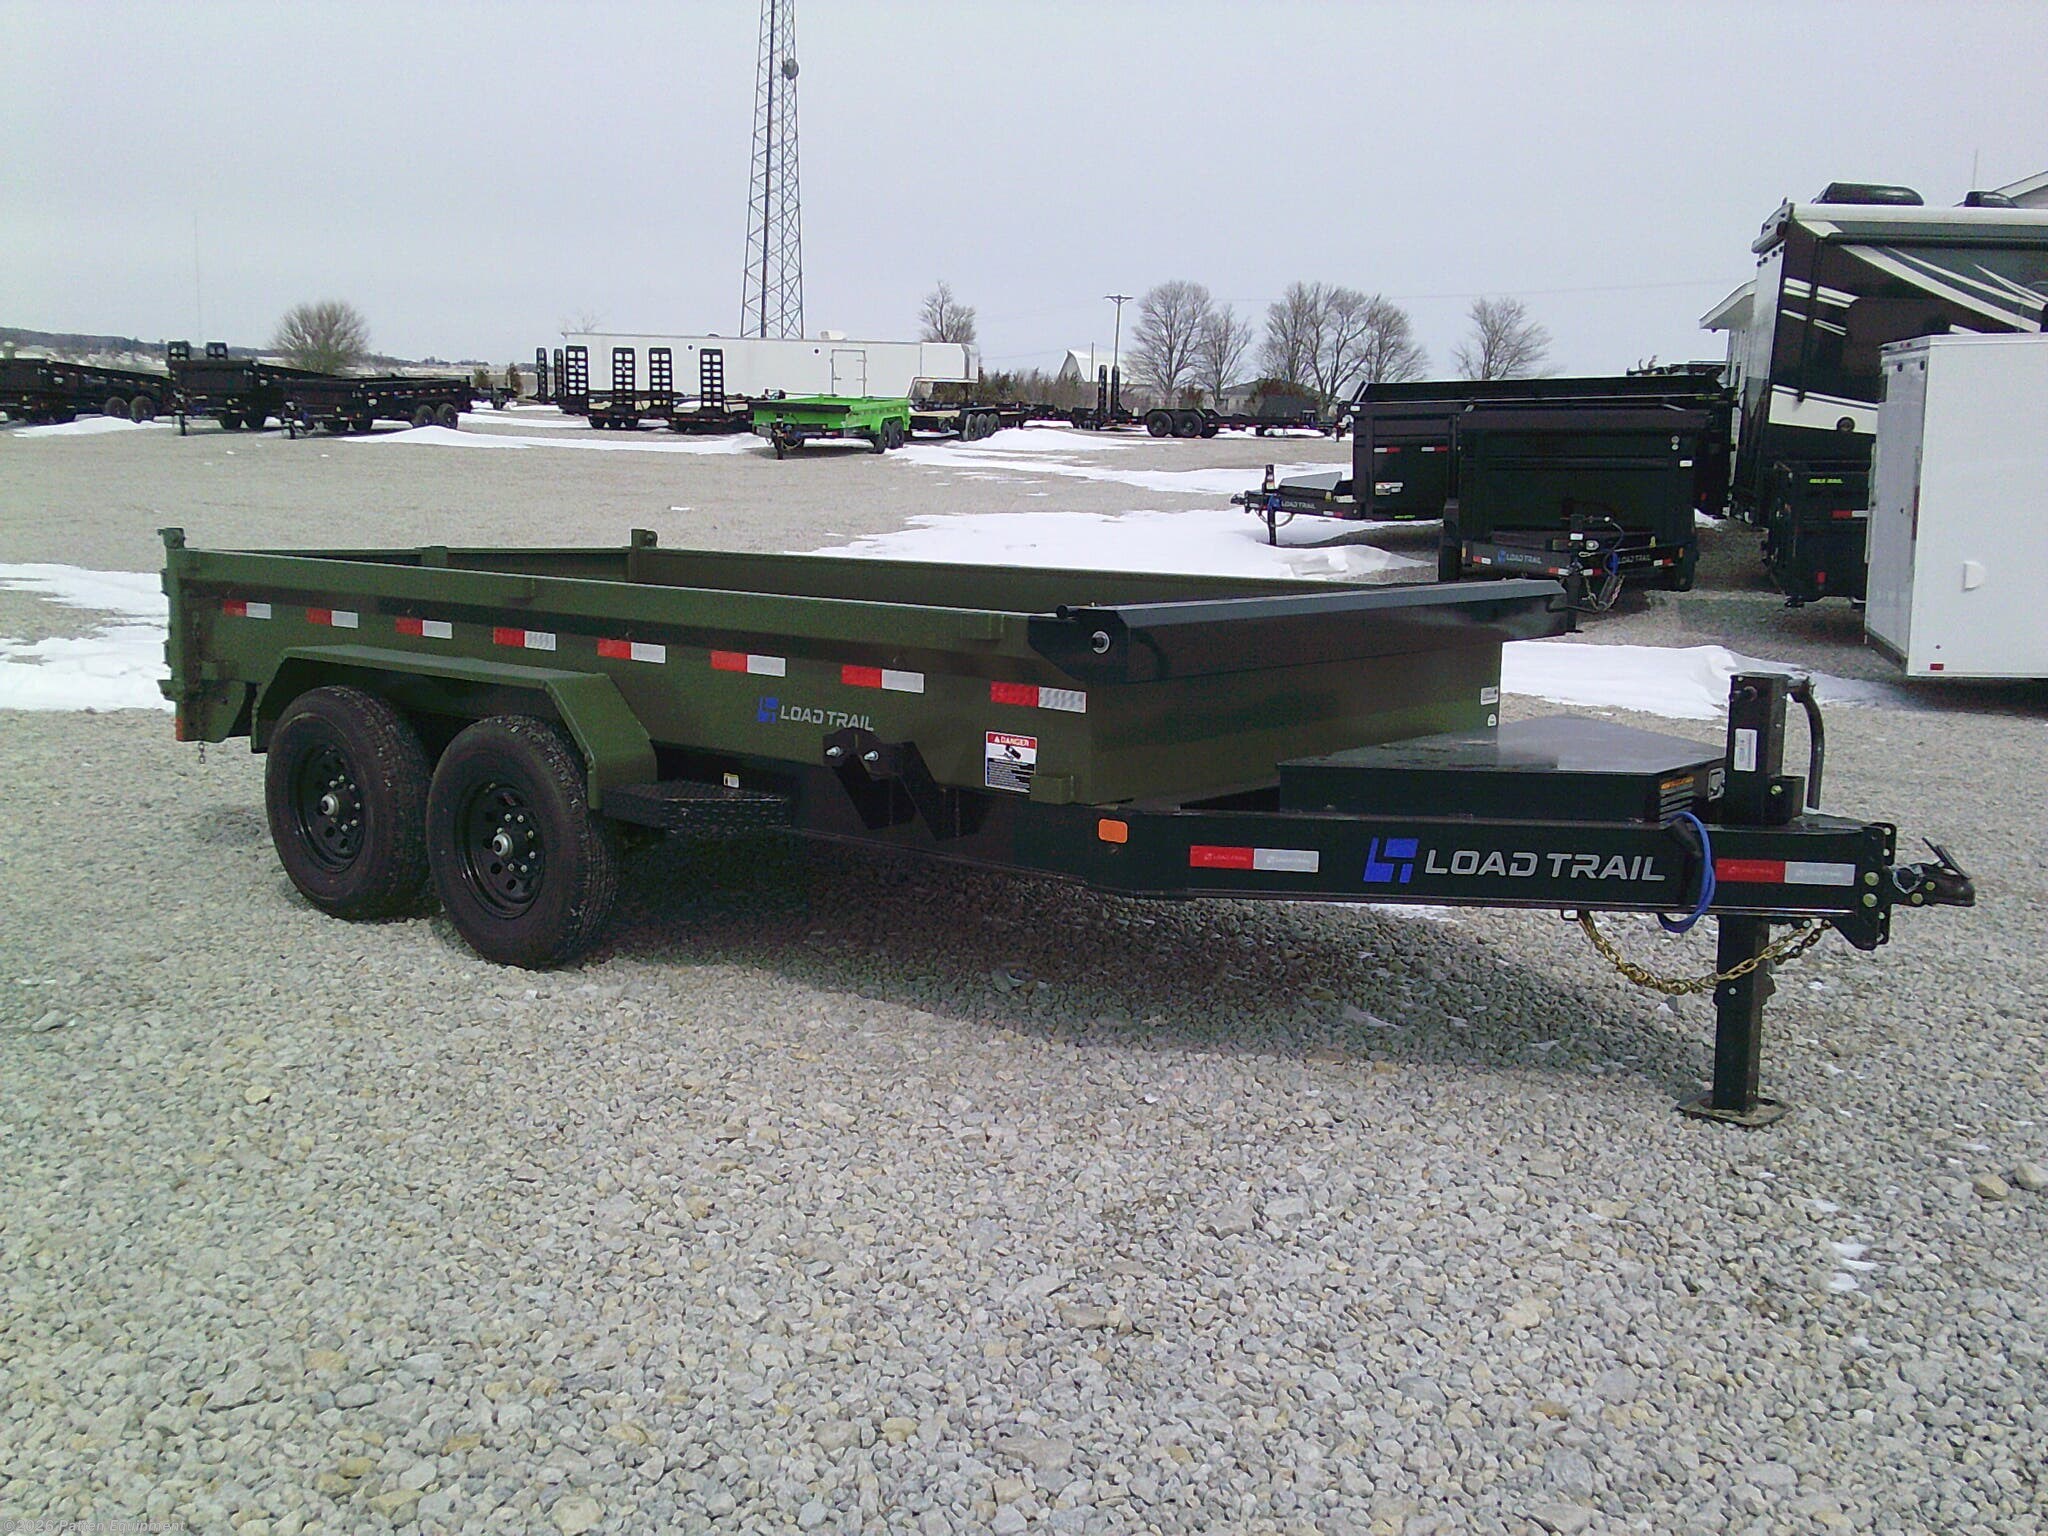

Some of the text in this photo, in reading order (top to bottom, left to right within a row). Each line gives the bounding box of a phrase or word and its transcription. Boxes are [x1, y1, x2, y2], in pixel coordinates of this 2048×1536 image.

[780, 705, 874, 731] LOAD TRAIL
[1424, 849, 1666, 881] LOAD TRAIL
